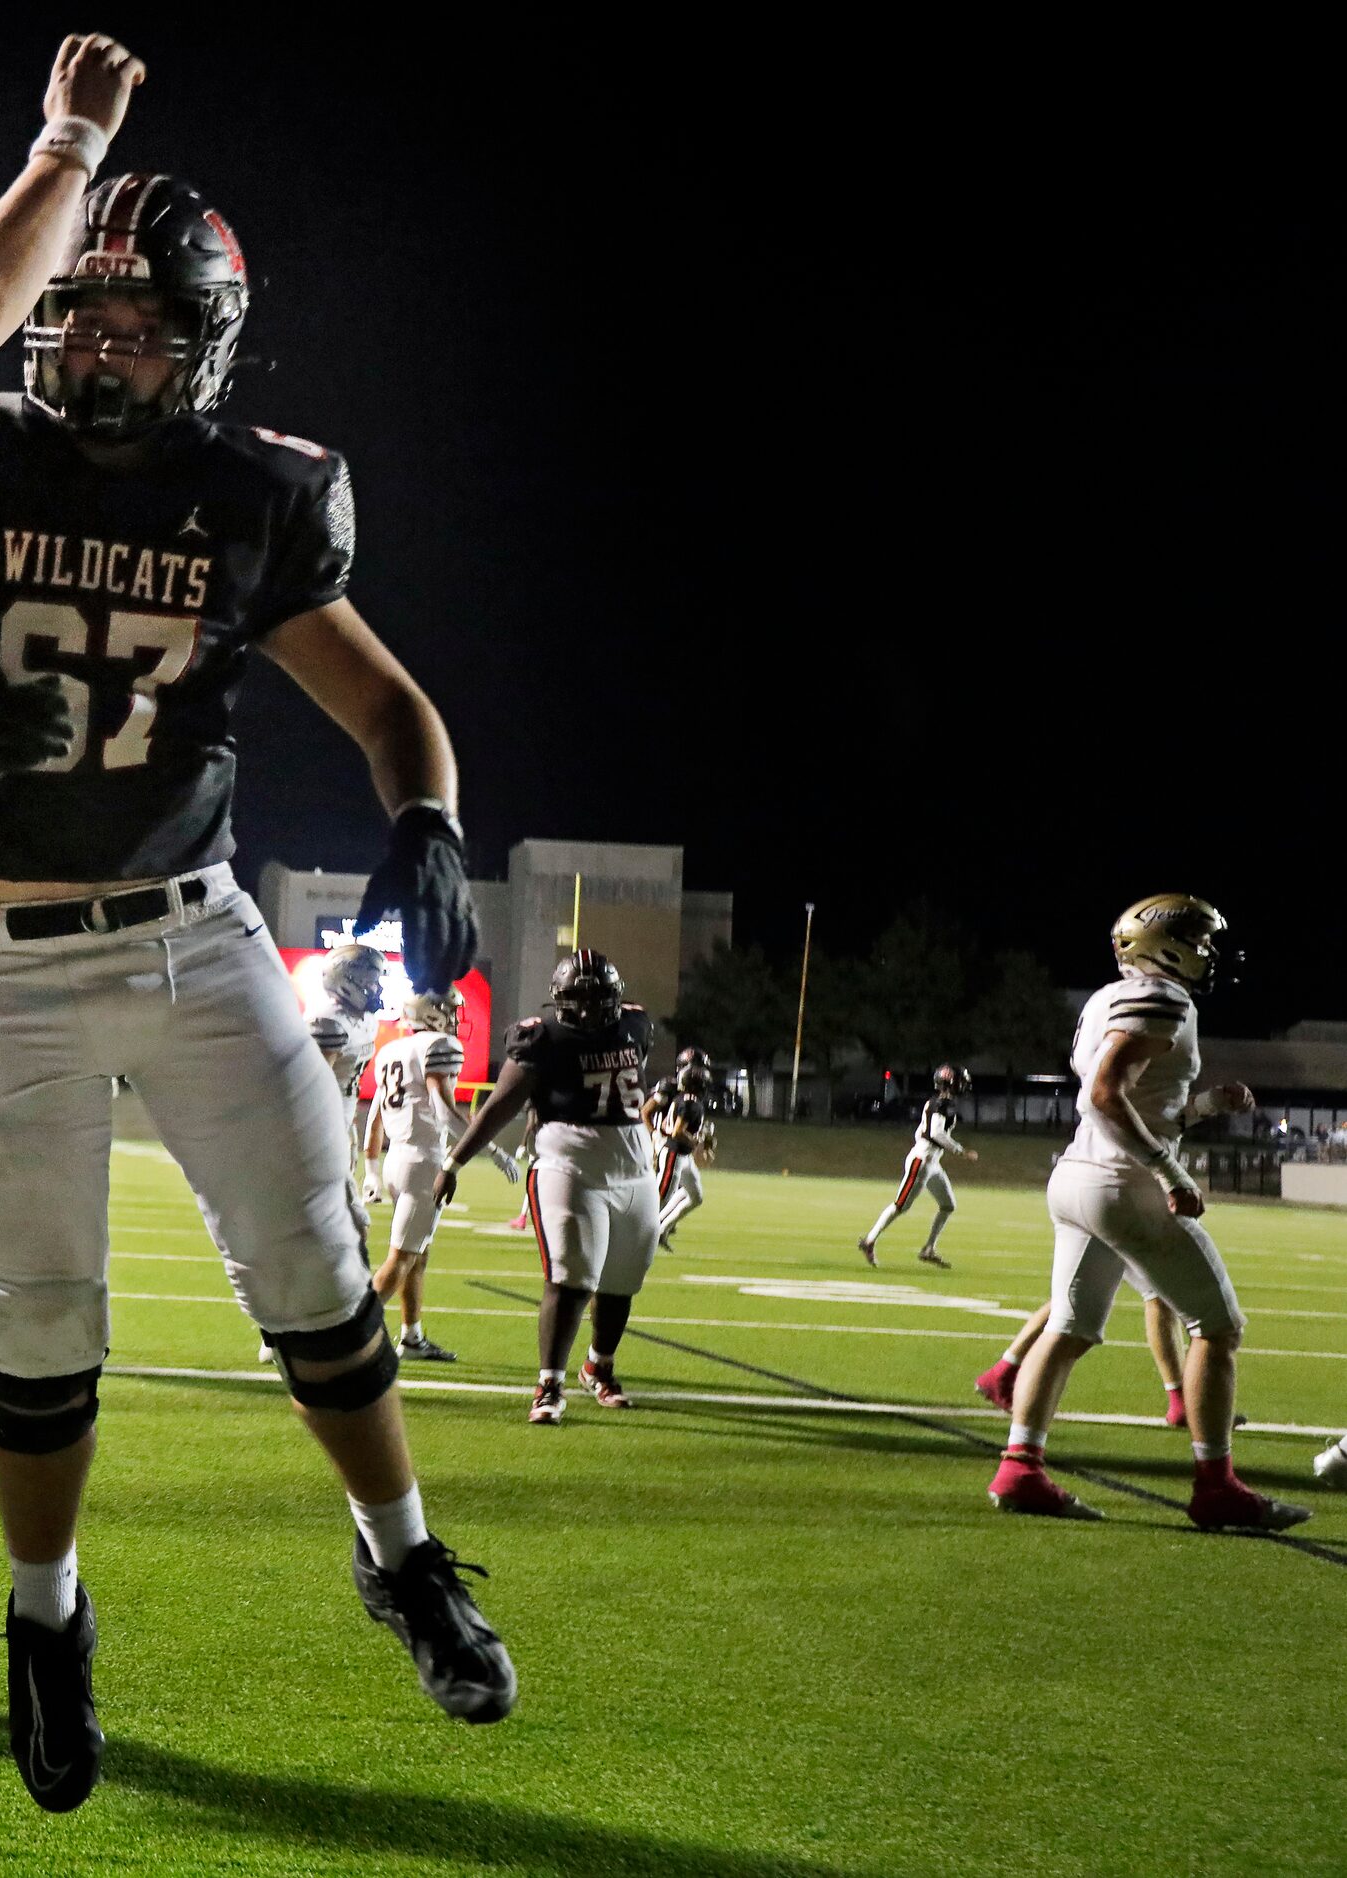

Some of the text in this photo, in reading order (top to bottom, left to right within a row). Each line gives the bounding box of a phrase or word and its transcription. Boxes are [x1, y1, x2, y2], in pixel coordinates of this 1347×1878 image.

[4, 529, 213, 608] WILDCATS
[0, 600, 202, 774] 67
[578, 1047, 640, 1072] WILDCATS
[583, 1067, 645, 1120] 76
